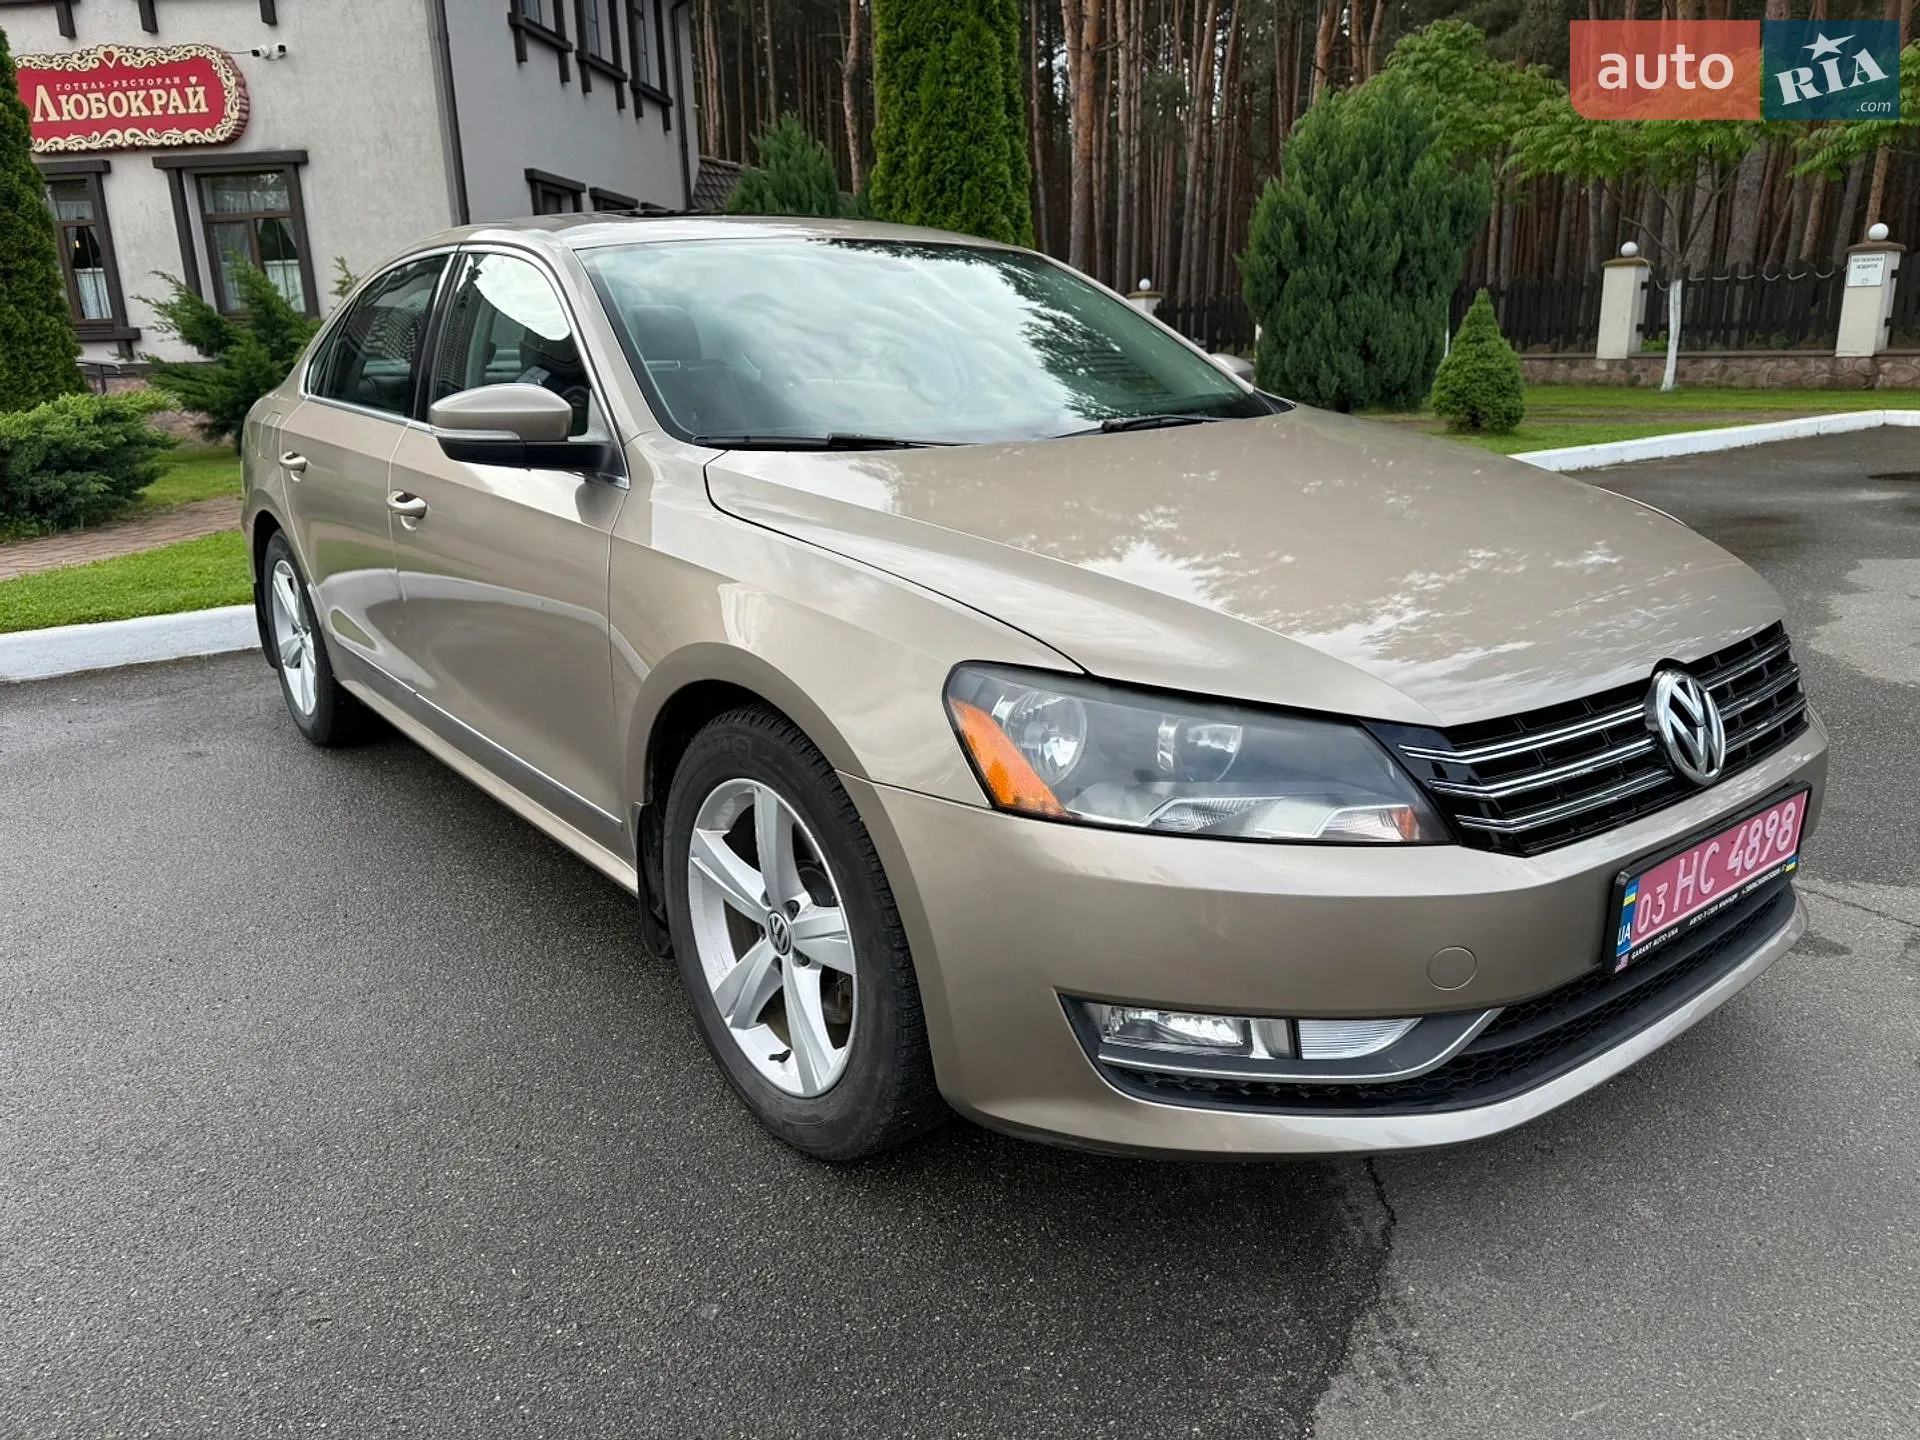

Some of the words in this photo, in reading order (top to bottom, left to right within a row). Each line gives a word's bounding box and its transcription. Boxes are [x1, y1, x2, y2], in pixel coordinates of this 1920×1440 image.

[55, 76, 181, 91] ГОТЕЛЬ-РЕСТОРАН
[33, 85, 209, 123] ЛЮБОКРАЙ
[1637, 882, 1668, 934] 03
[1673, 842, 1720, 913] HC
[1727, 802, 1796, 877] 4898
[1617, 922, 1631, 946] UA
